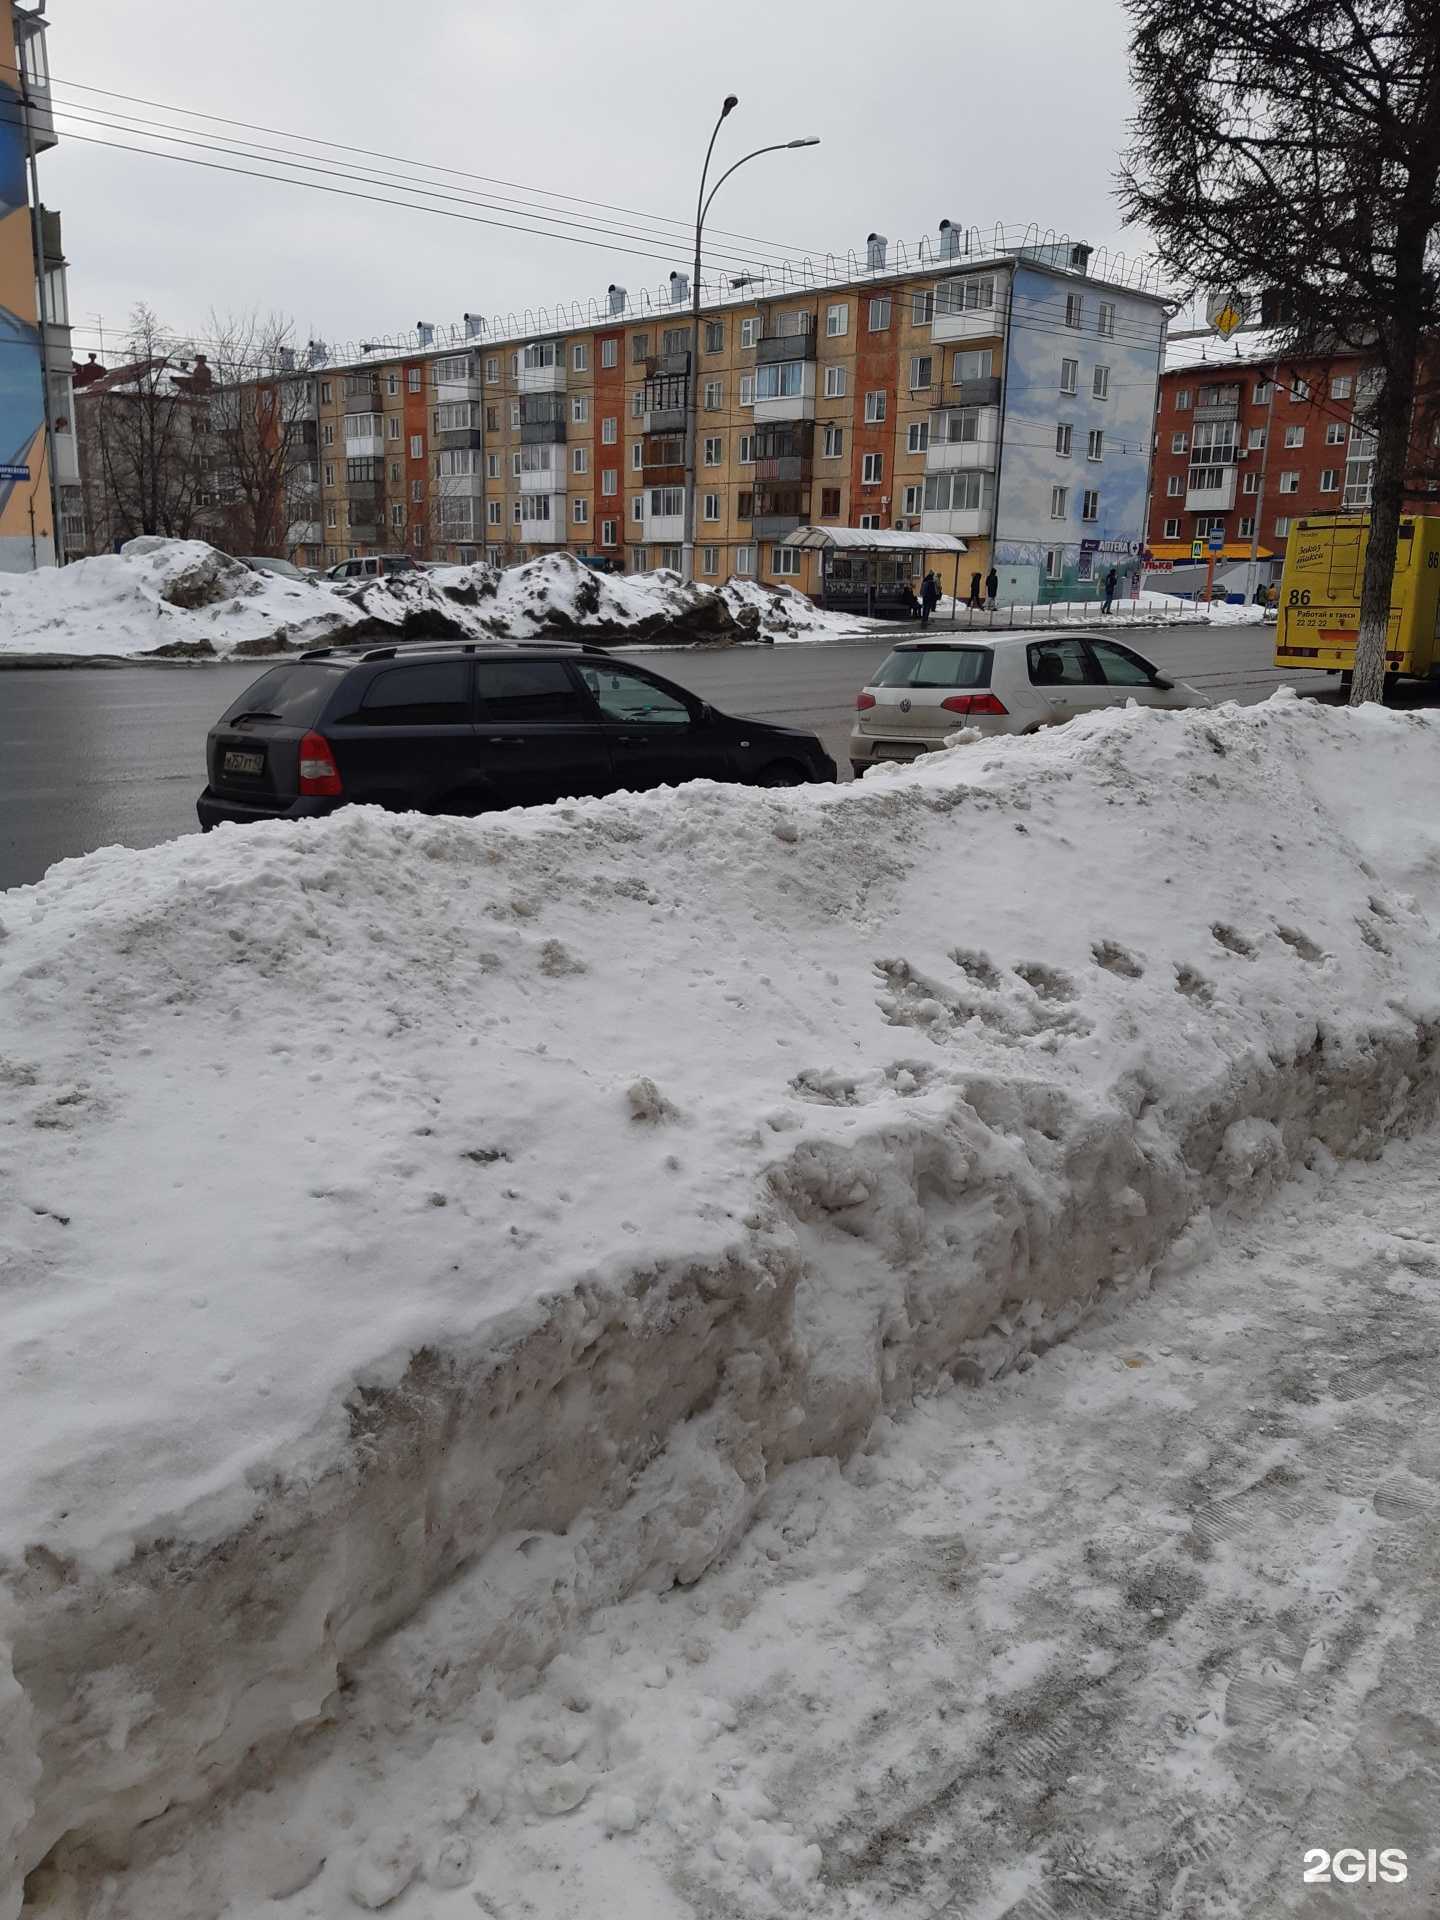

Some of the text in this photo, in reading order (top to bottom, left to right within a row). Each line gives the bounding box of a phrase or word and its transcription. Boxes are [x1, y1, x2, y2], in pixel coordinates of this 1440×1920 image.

[1098, 541, 1128, 552] АПТЕКА
[1428, 552, 1440, 568] 86
[1289, 589, 1311, 605] 86
[1297, 610, 1327, 618] Работай
